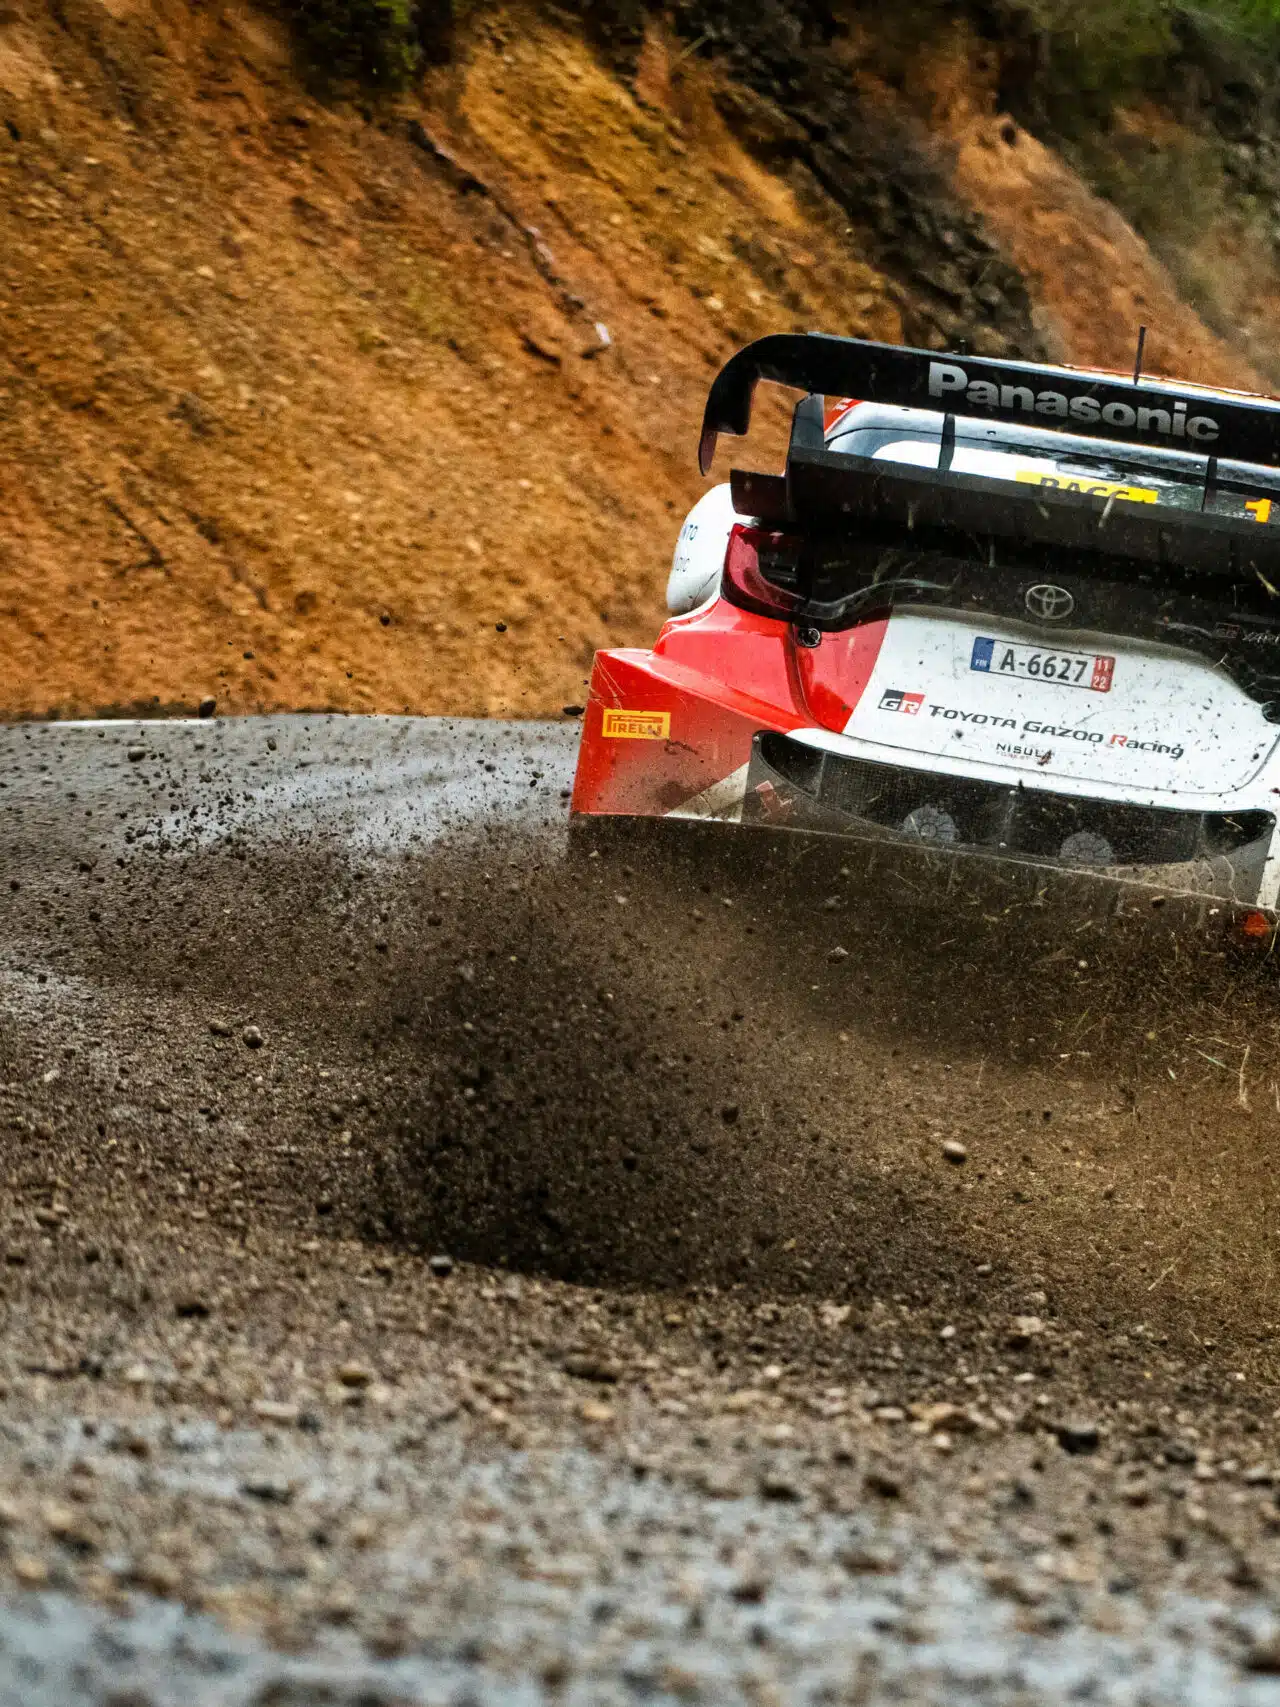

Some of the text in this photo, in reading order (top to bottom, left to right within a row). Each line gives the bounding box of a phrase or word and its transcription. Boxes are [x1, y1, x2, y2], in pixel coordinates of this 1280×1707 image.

[928, 361, 1220, 441] Panasonic
[1245, 498, 1271, 523] 1
[1000, 648, 1088, 683] A-6627
[1092, 675, 1107, 689] 22
[879, 694, 1185, 759] GR TOYOTA GAZOO Racing
